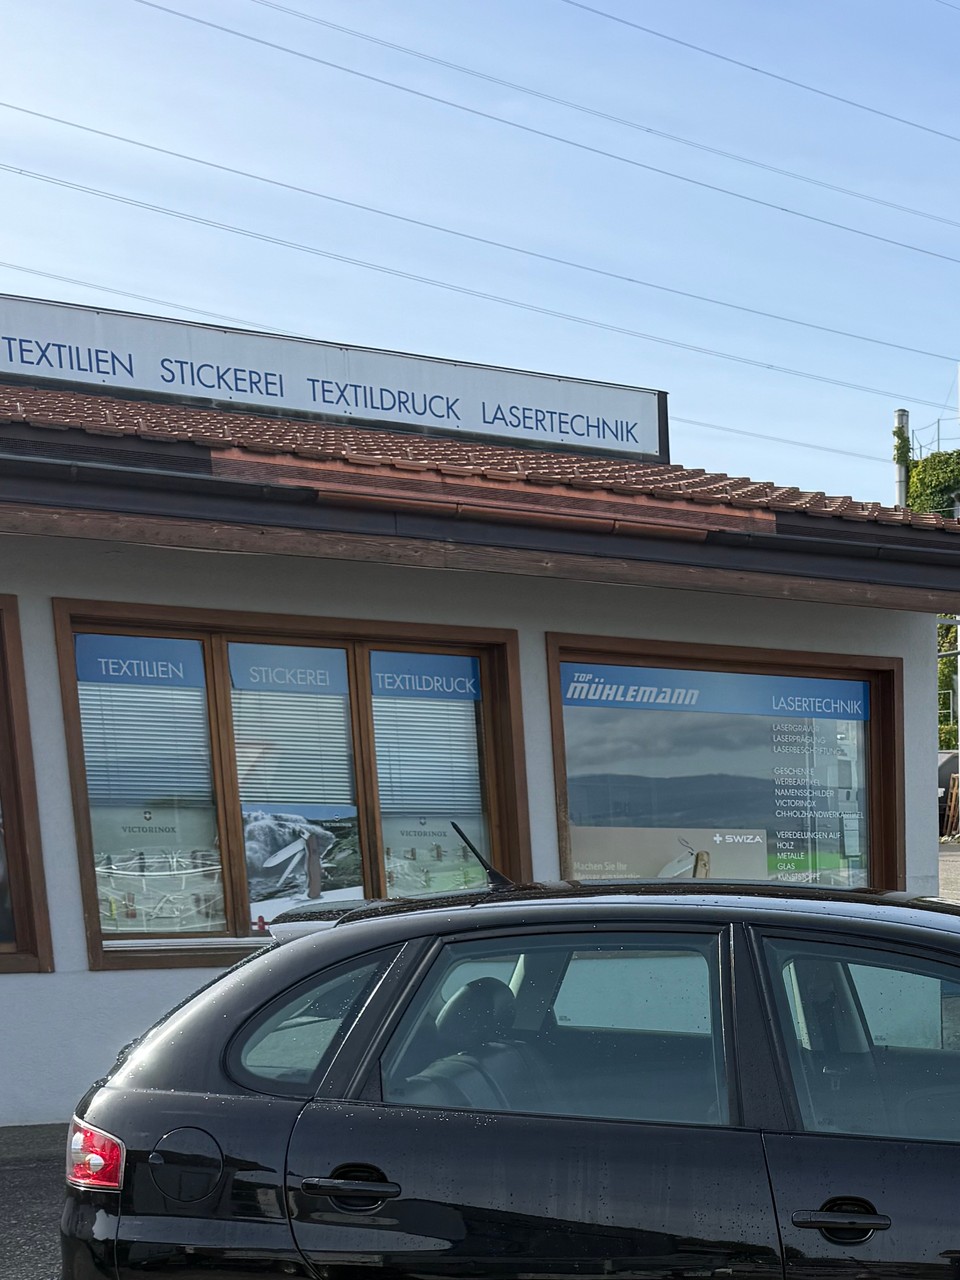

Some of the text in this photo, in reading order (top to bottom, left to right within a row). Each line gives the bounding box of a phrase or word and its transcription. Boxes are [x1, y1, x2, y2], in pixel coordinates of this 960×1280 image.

[2, 335, 639, 444] TEXTILIEN STICKEREI TEXTILDRUCK LASERTECHNIK
[98, 658, 184, 679] TEXTILIEN
[249, 666, 330, 686] STICKEREI
[573, 673, 593, 682] TOP
[375, 673, 477, 694] TEXTILDRUCK
[566, 677, 700, 705] MÜHLEMANN
[772, 695, 862, 714] LASERTECHNIK
[775, 788, 834, 797] NAMENSSCHILDER
[775, 799, 816, 807] VICTORINOX
[121, 826, 177, 834] VICTORINOX
[400, 830, 447, 838] VICTORINOX
[725, 835, 763, 843] SWIZA
[776, 831, 828, 839] VEREDELUNGEN
[776, 841, 794, 849] HOLZ
[777, 852, 805, 860] METALLE
[573, 862, 604, 871] Machen
[604, 861, 616, 871] Sie
